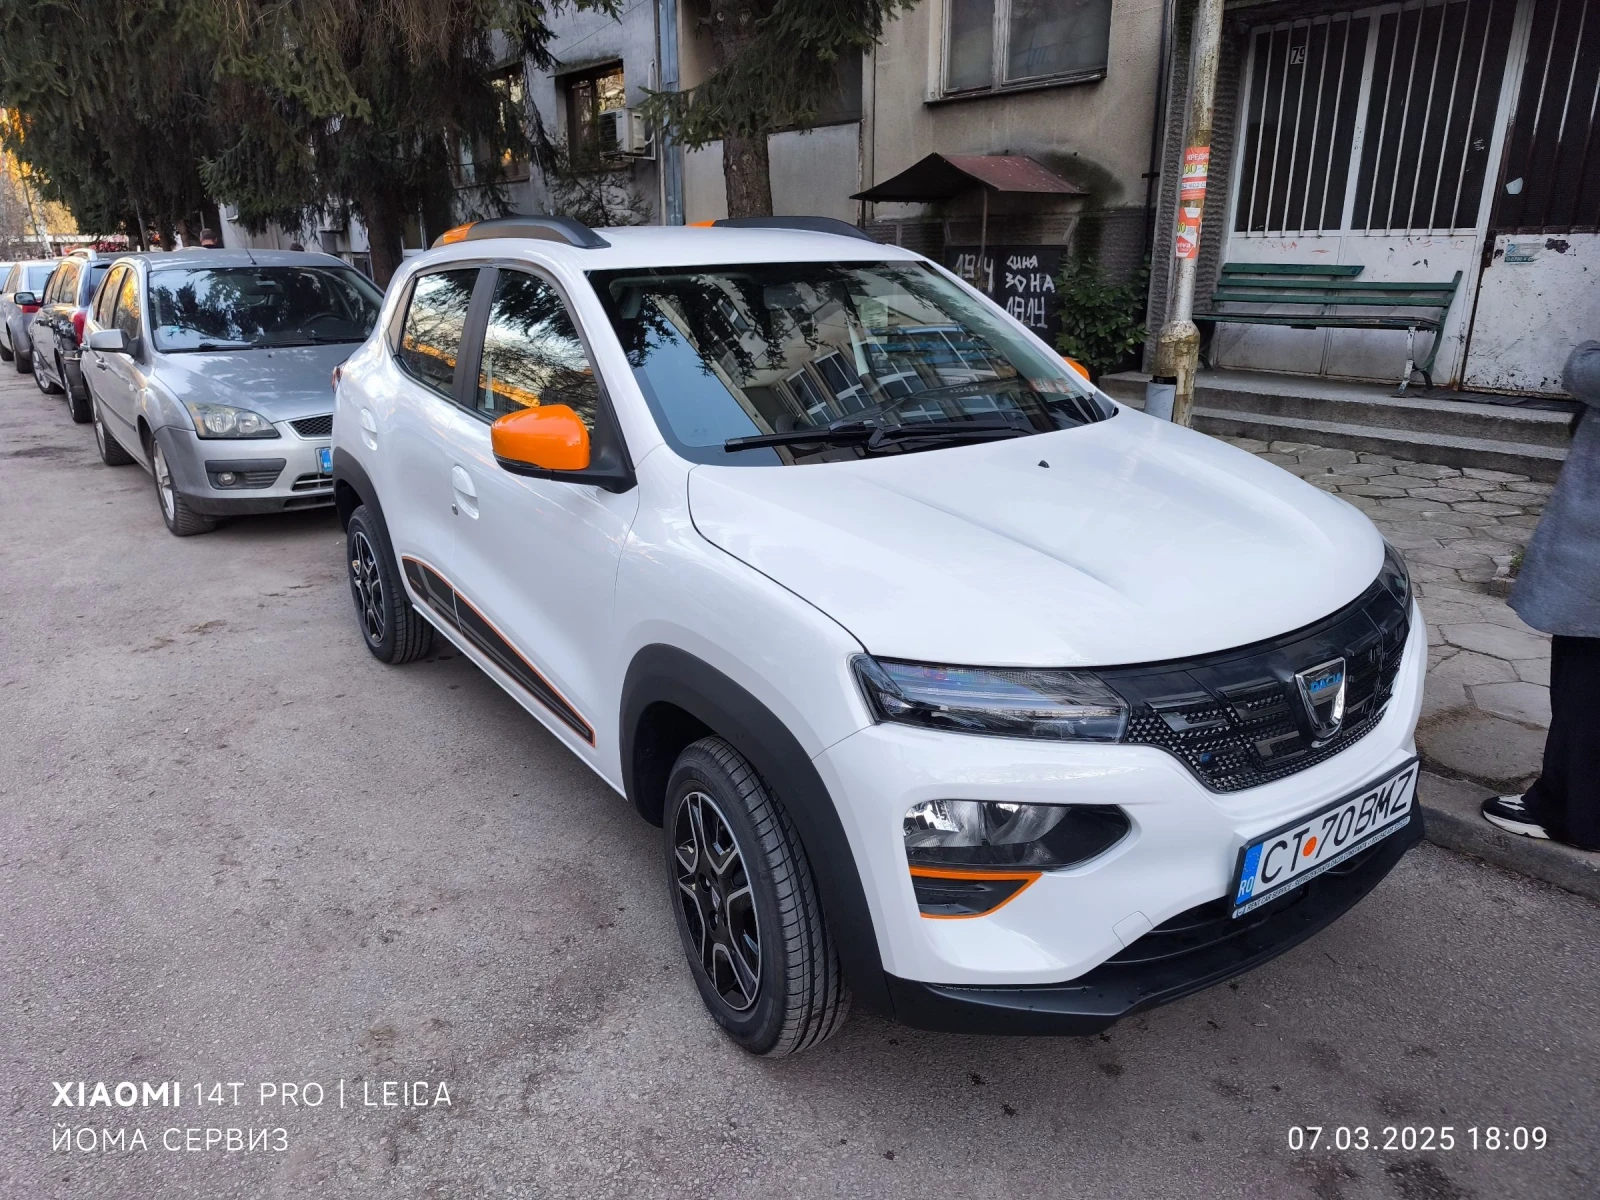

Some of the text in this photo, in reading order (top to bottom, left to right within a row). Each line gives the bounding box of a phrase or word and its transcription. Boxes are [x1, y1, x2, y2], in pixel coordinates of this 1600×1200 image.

[1310, 672, 1343, 693] DACIA
[1261, 827, 1311, 884] CT
[1238, 875, 1255, 898] RO
